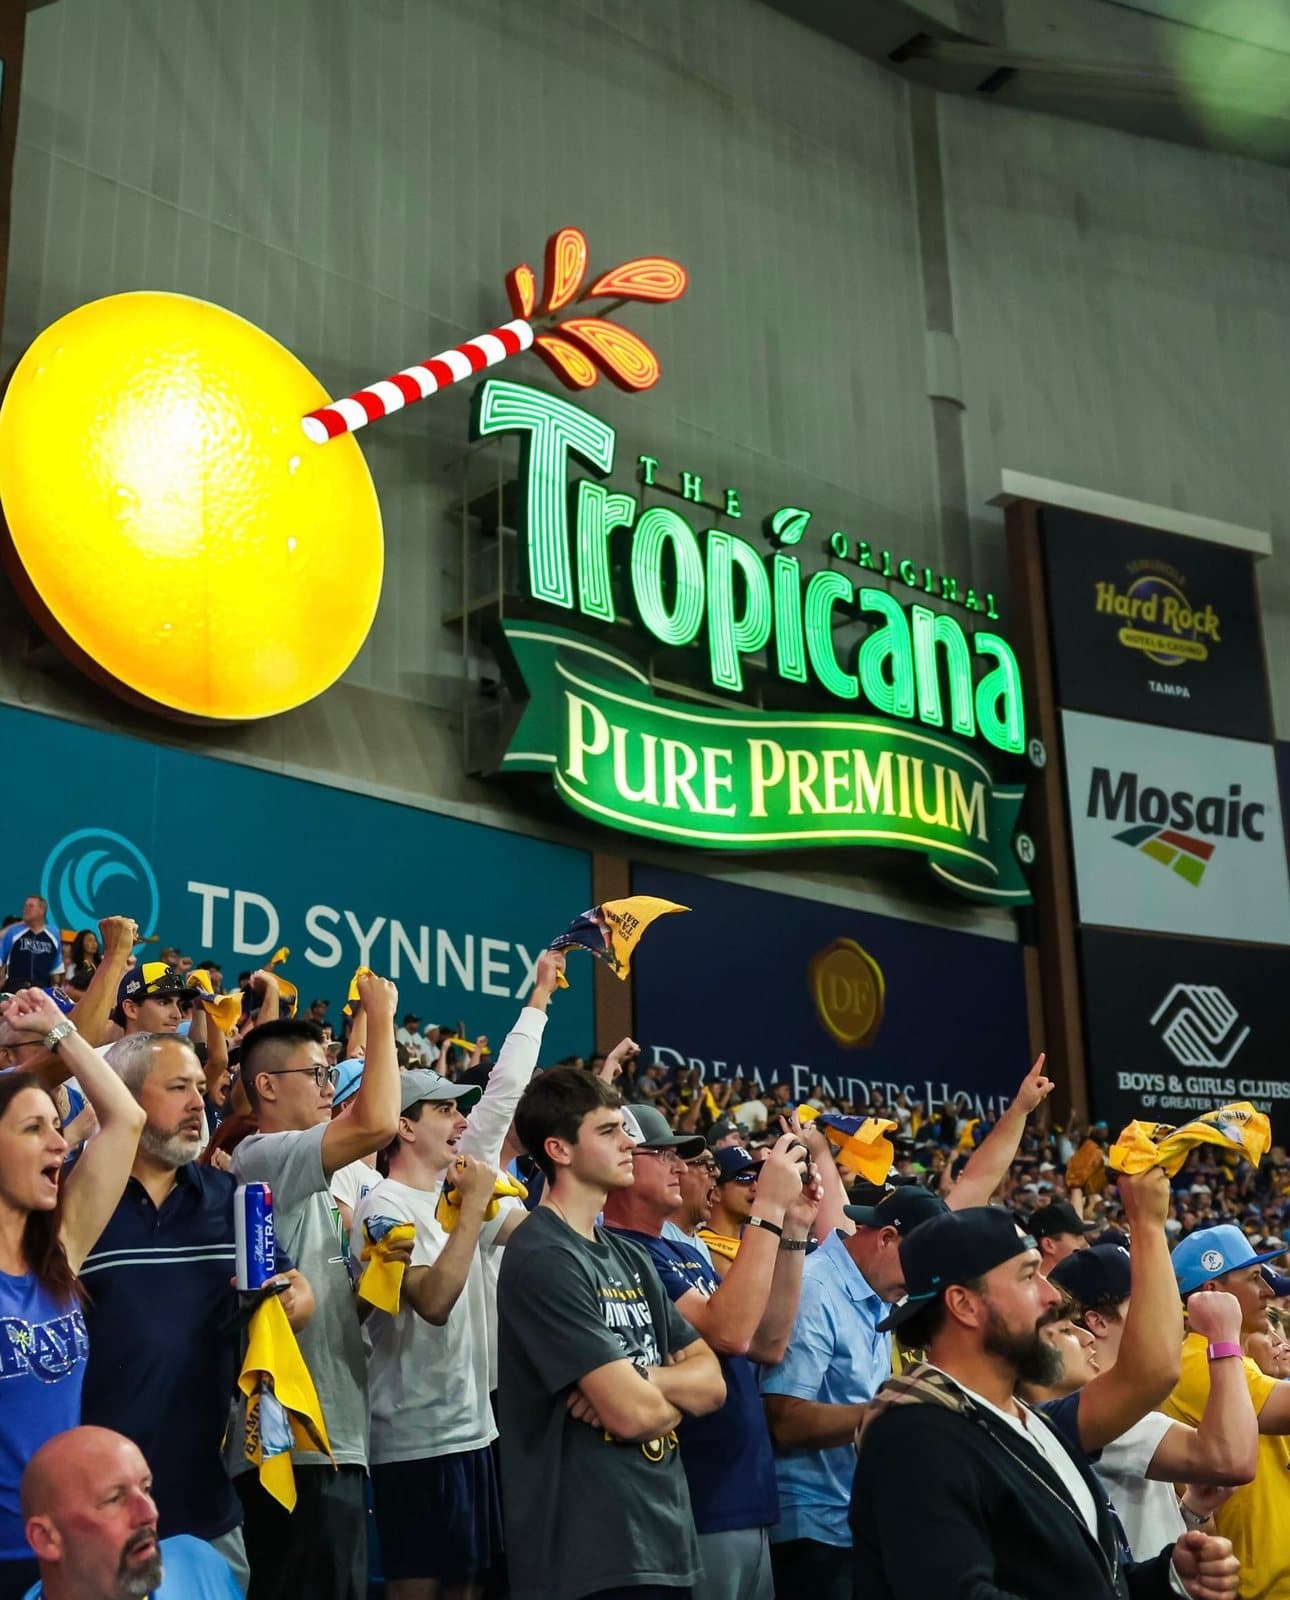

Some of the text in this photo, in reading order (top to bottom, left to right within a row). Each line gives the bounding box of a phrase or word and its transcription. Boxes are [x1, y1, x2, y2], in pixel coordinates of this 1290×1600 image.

[477, 378, 1026, 755] Tropicana
[639, 455, 999, 620] THE ORIGINAL
[1096, 581, 1221, 641] Hard Rock
[1148, 680, 1191, 698] TAMPA
[564, 690, 737, 818] PURE
[746, 737, 990, 843] PREMIUM
[1086, 766, 1265, 842] Mosaic
[188, 881, 553, 1005] TD SYNNEX
[829, 974, 870, 1015] DF
[791, 1064, 917, 1113] FNDRS
[1118, 1072, 1290, 1099] BOYS & GIRLS CLUBS
[1142, 1095, 1158, 1108] OF
[1160, 1097, 1212, 1110] GREATER
[264, 1213, 275, 1271] ULTRA
